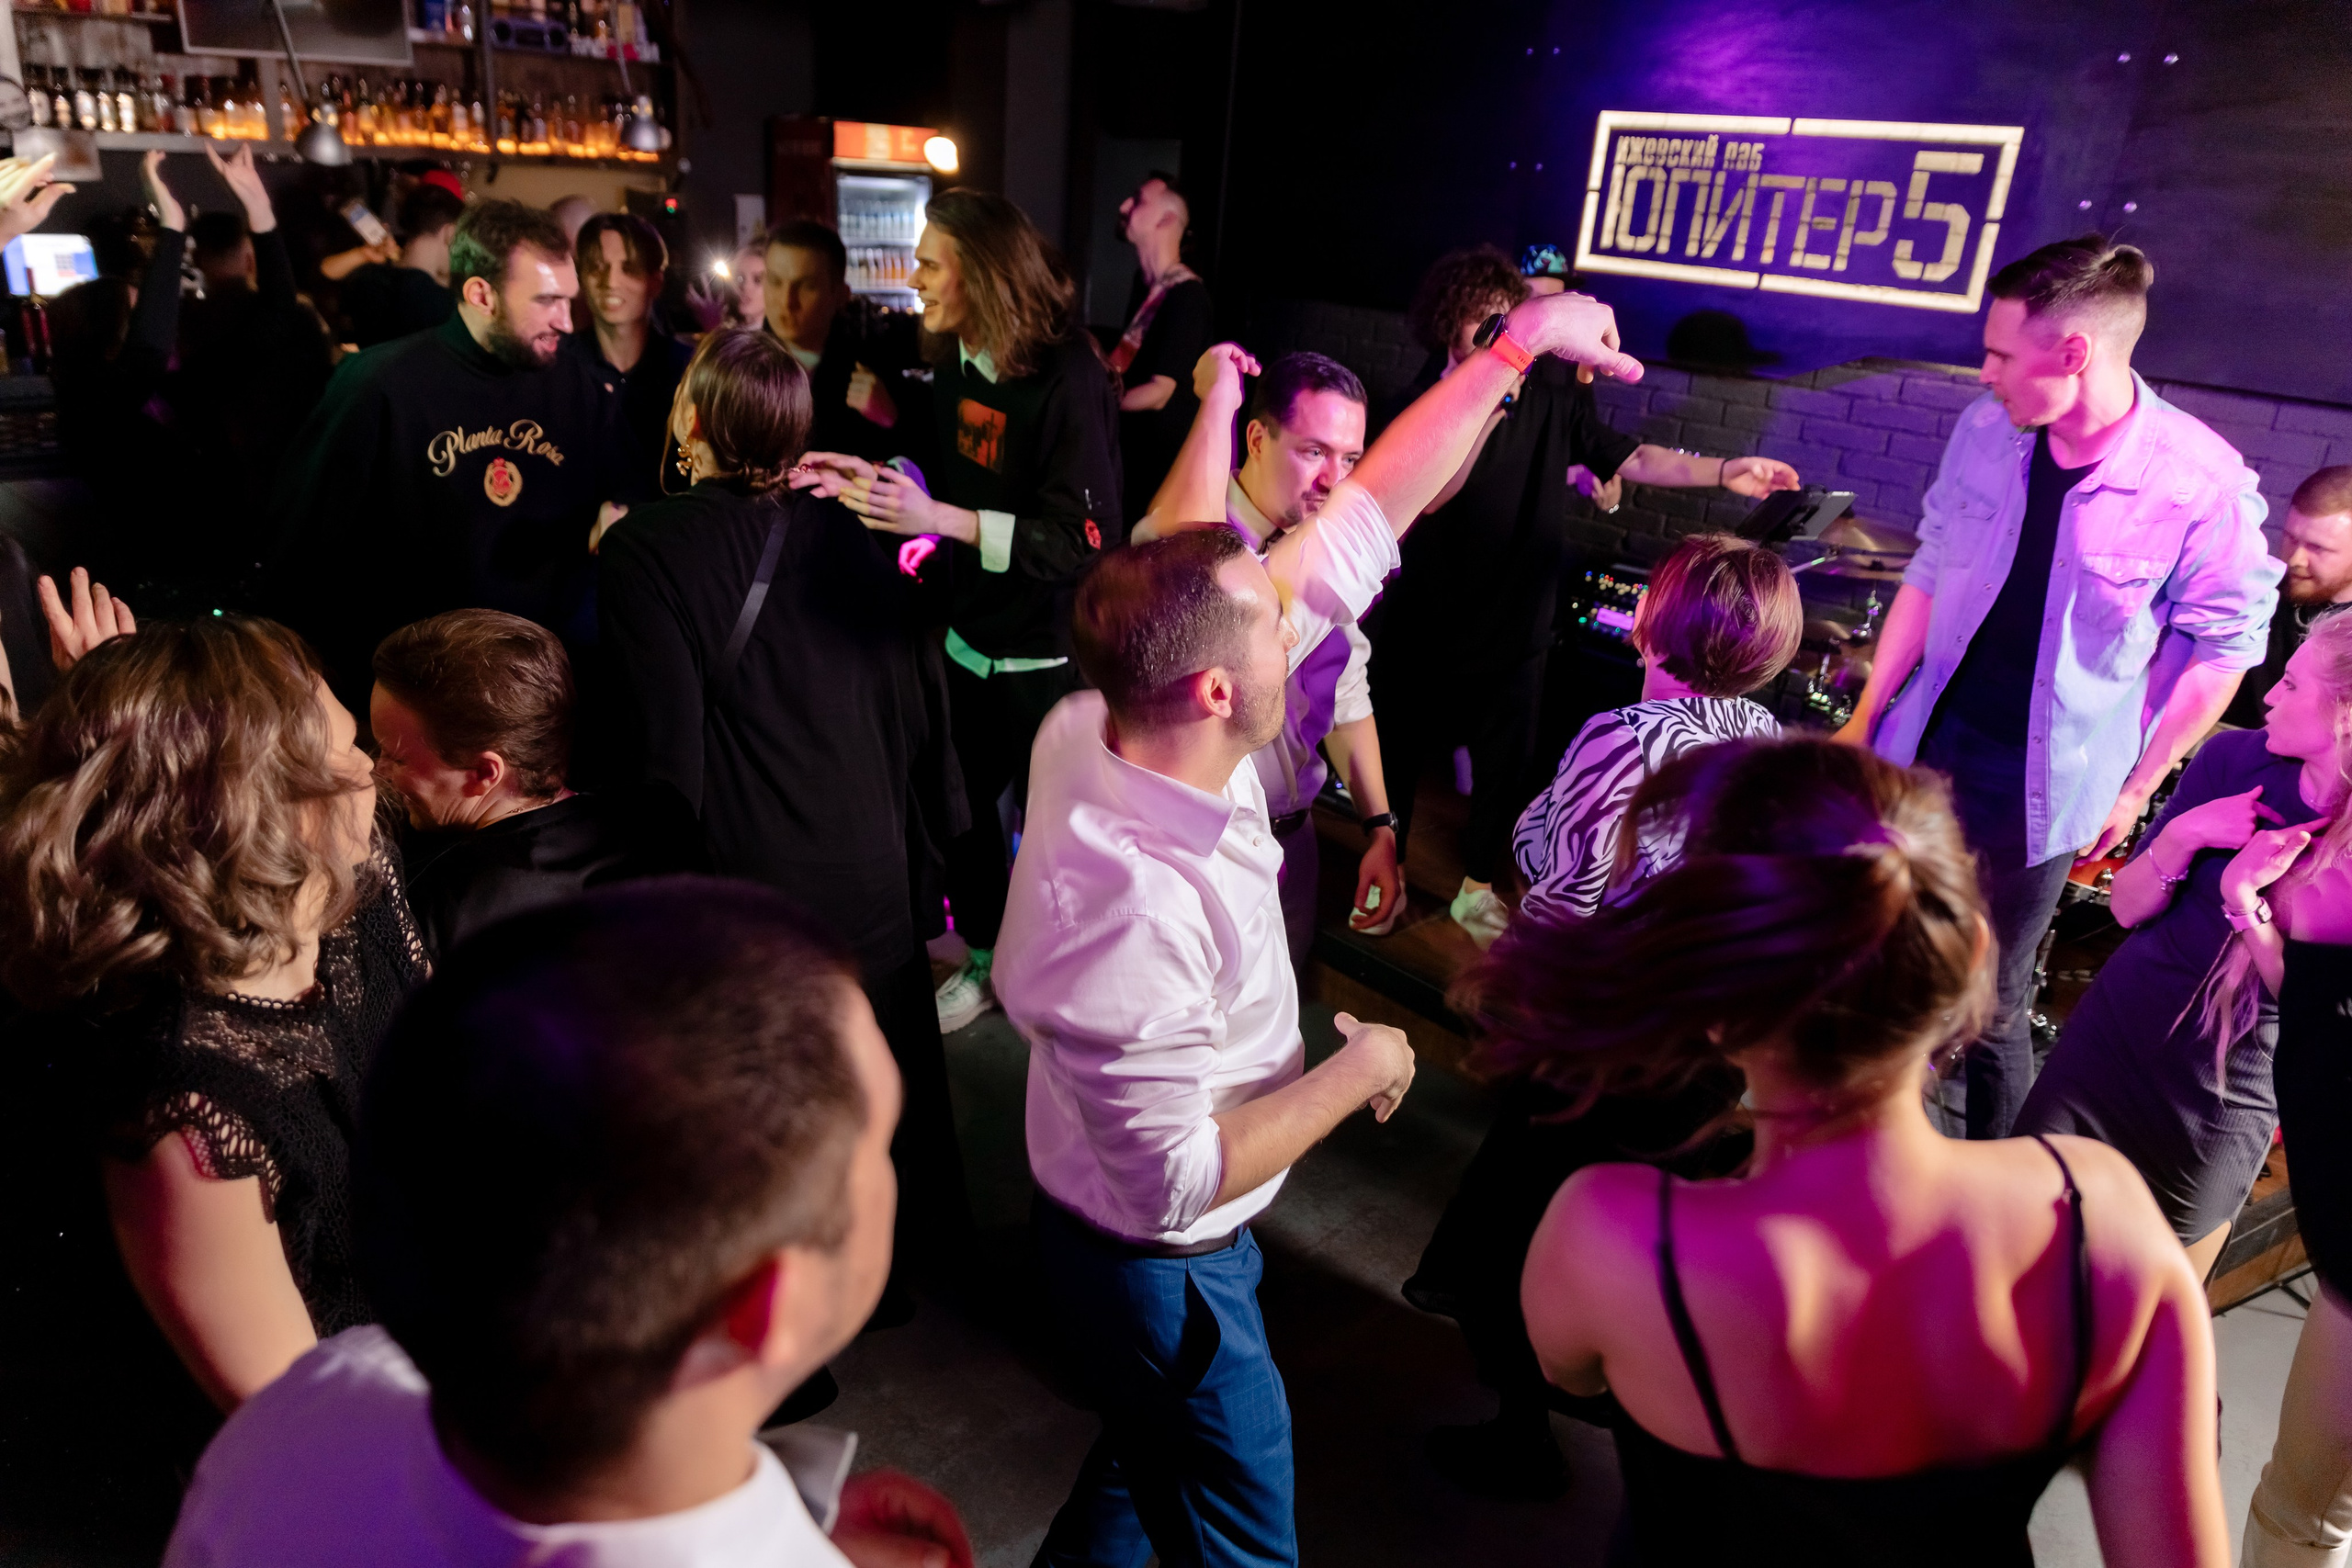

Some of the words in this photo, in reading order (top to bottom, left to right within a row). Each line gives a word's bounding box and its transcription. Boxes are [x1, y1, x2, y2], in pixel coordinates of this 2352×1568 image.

[1599, 163, 1897, 271] ЮПИТЕР
[1892, 150, 1984, 282] 5
[427, 425, 503, 477] Planta
